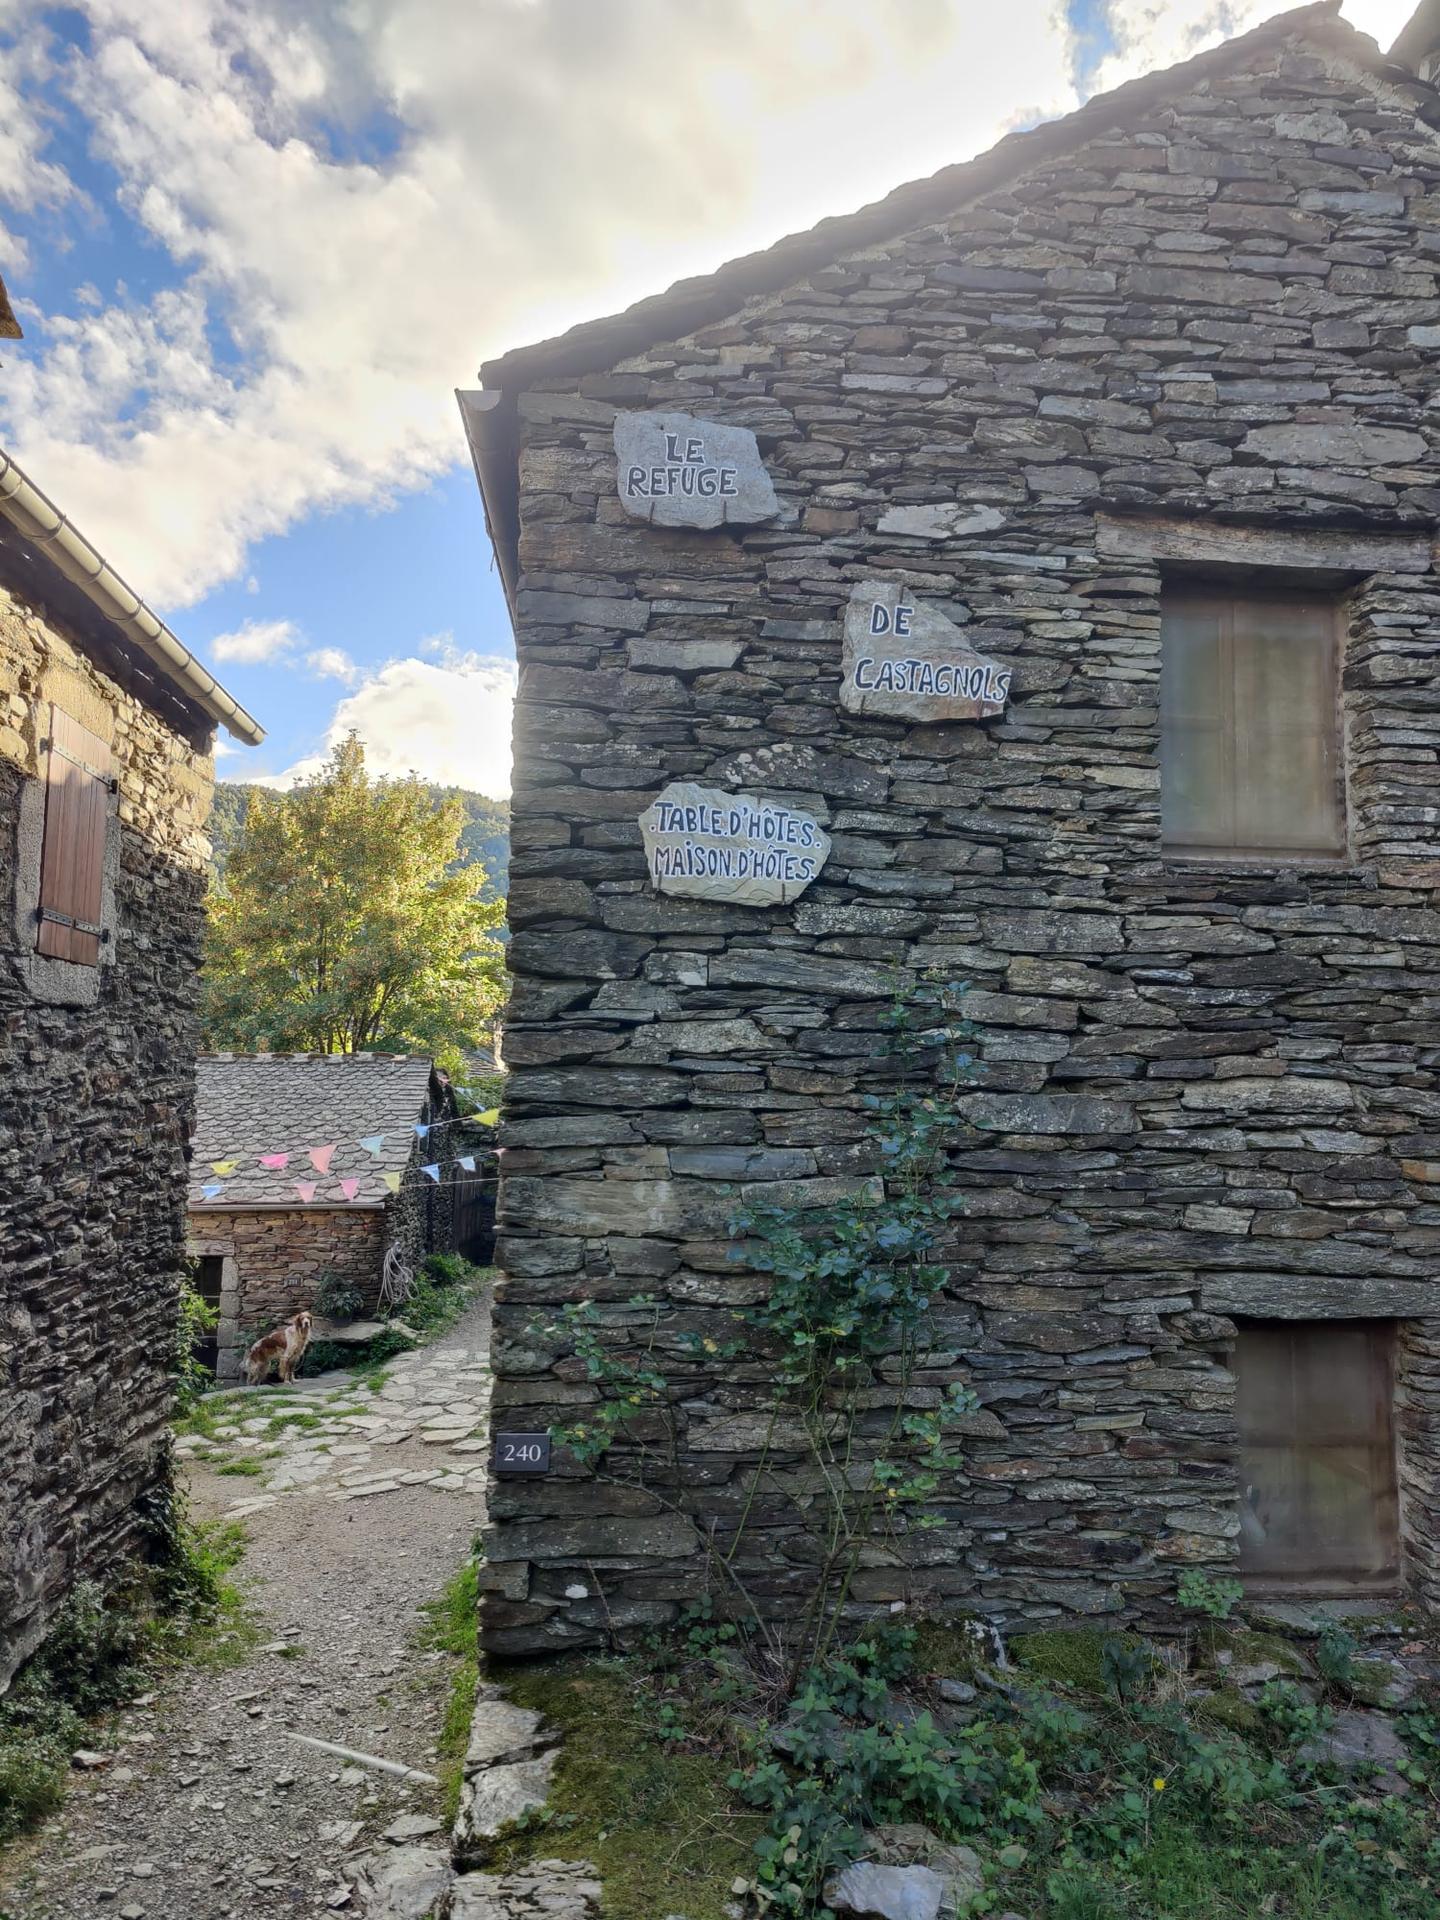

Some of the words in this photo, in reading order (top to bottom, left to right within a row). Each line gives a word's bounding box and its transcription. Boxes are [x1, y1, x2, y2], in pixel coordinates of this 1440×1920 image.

[665, 434, 704, 465] LE
[626, 466, 738, 497] REFUGE
[870, 603, 913, 636] DE
[855, 658, 1012, 703] CASTAGNOLS
[504, 1444, 541, 1462] 240
